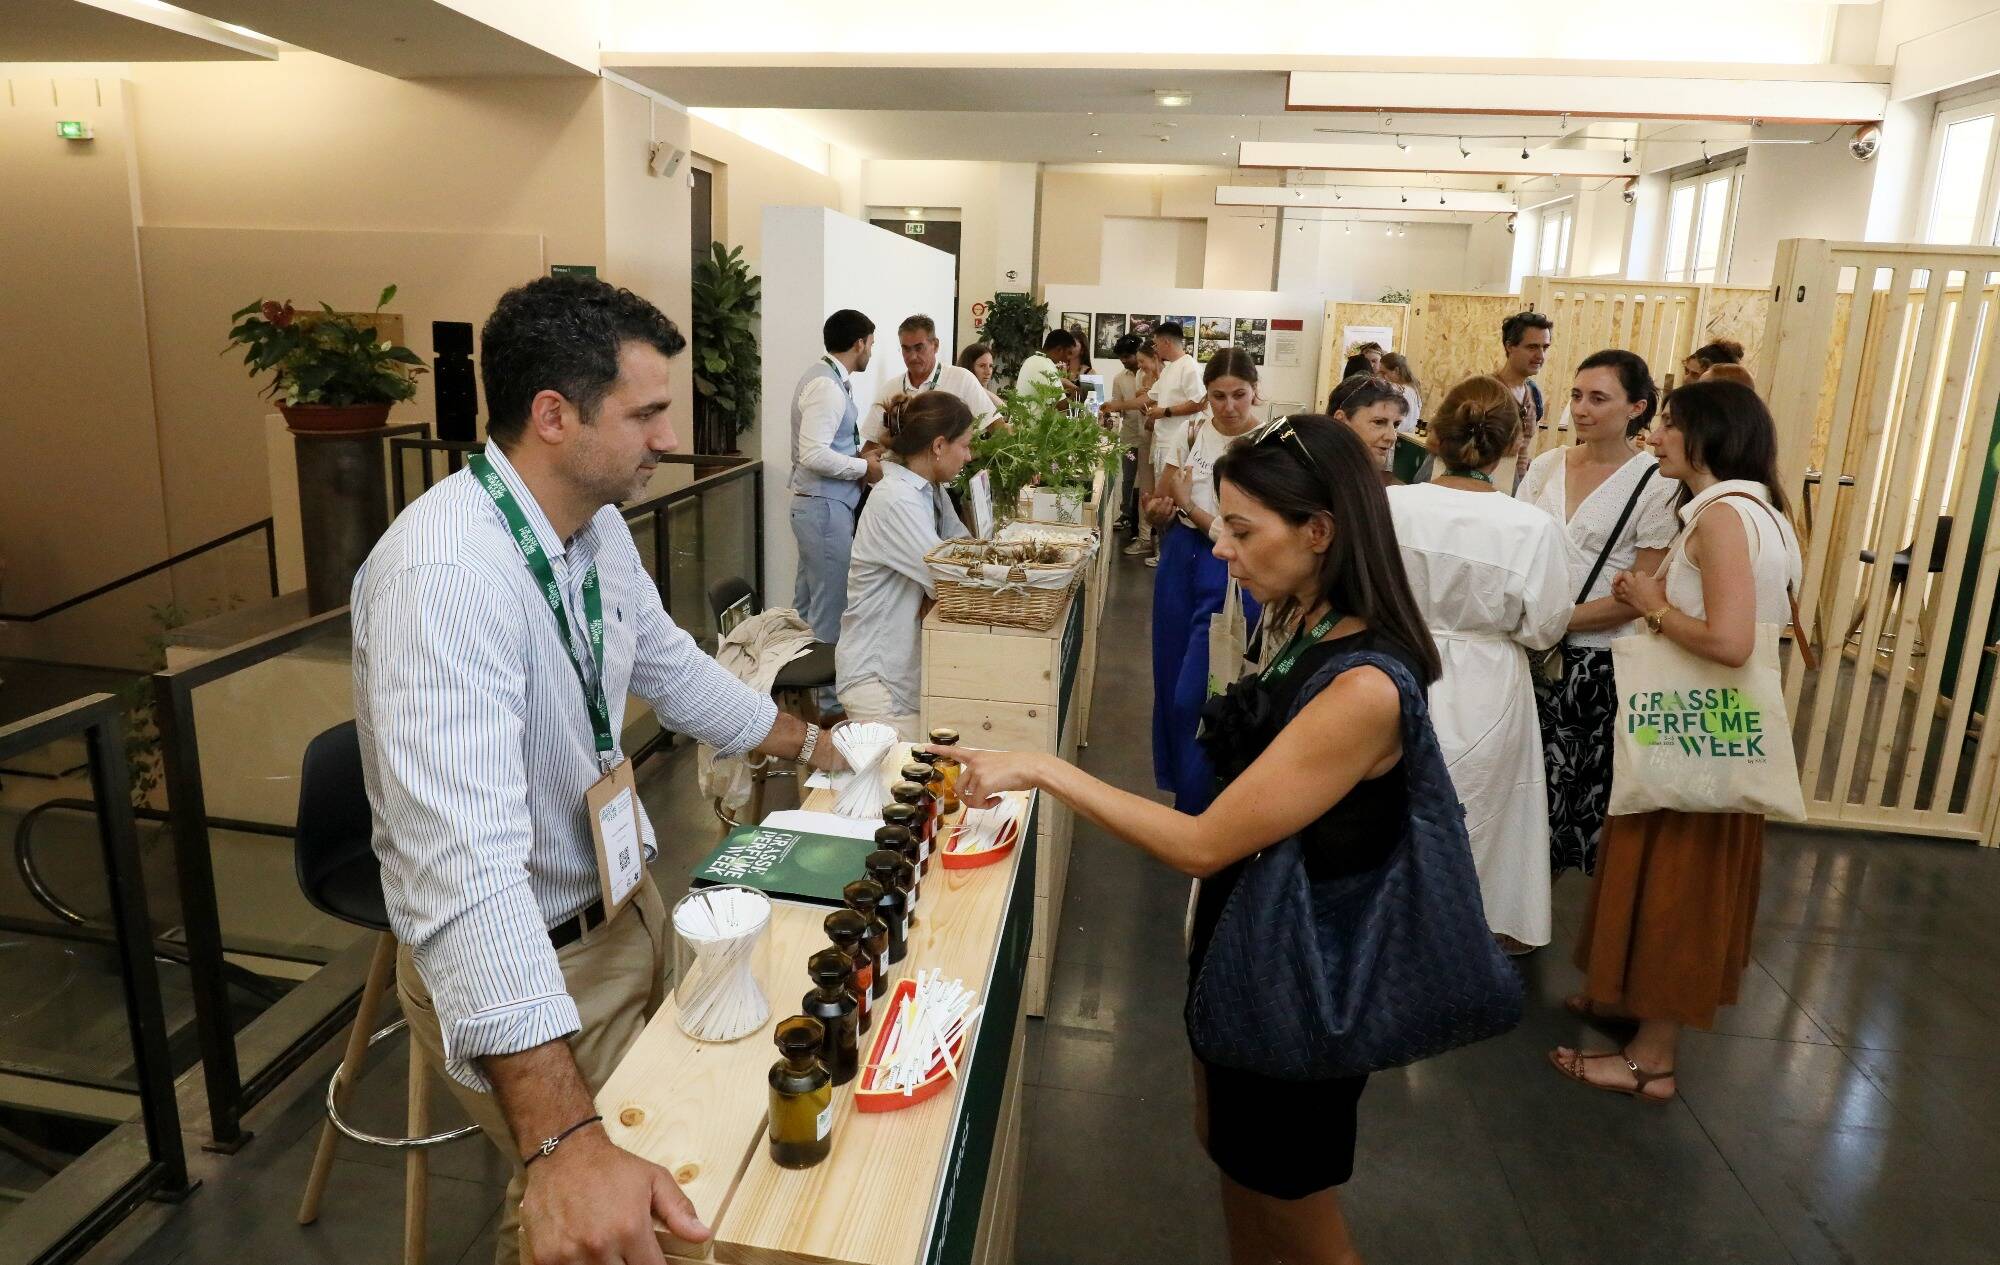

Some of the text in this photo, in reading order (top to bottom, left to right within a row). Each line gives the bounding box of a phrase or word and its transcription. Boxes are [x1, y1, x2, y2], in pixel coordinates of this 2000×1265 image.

[1629, 688, 1740, 711] GRASSE
[1628, 712, 1762, 733] PERFUME
[1677, 734, 1766, 757] WEEK
[704, 845, 747, 877] WEEK
[724, 831, 777, 878] PERFUME
[748, 833, 793, 875] GRASSE
